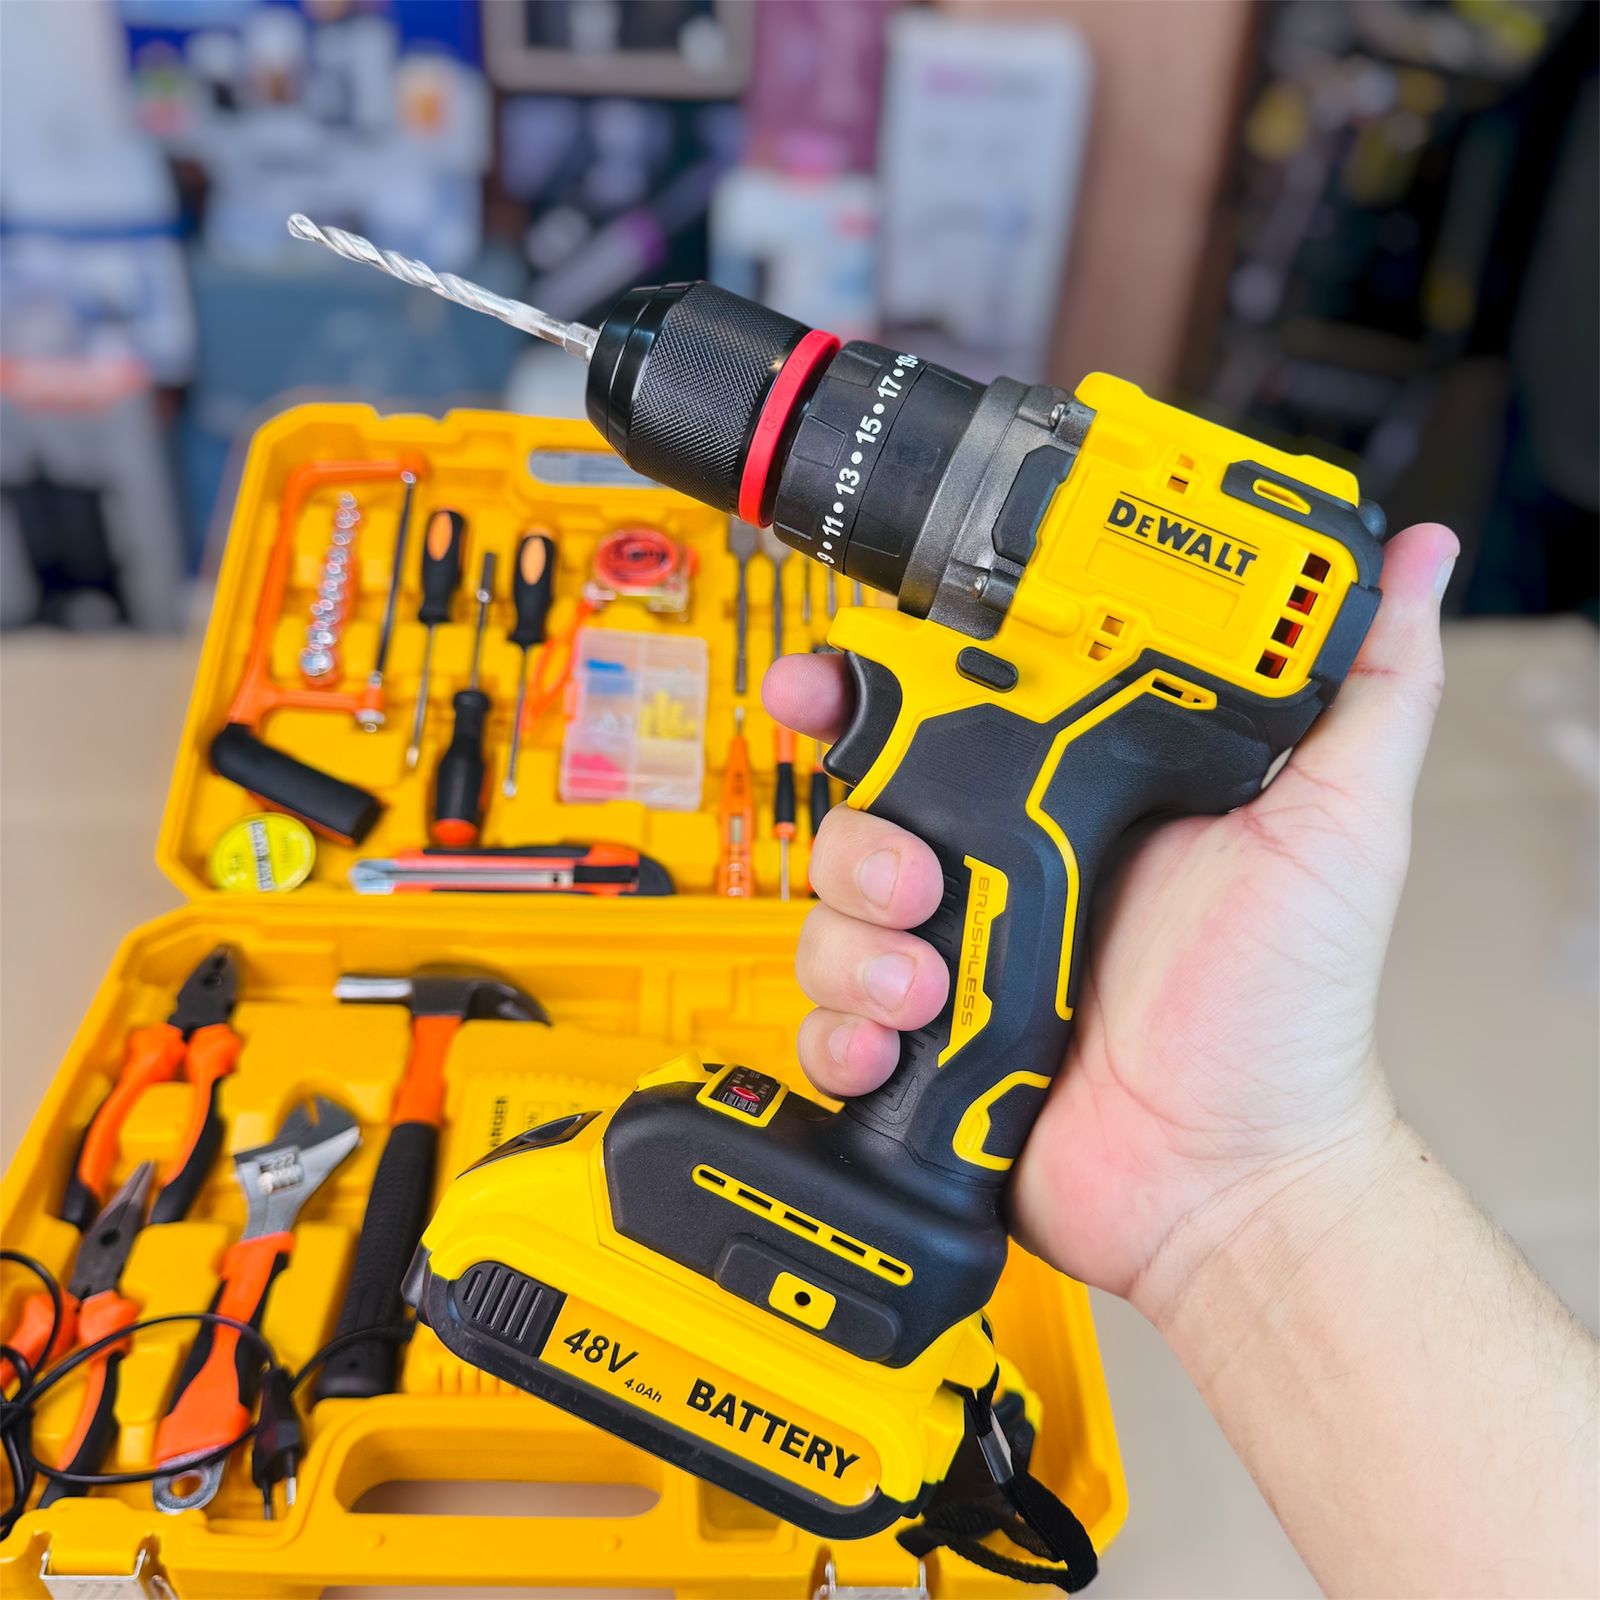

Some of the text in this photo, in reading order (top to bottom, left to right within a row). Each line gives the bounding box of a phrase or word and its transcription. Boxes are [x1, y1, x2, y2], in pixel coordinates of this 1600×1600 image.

[816, 354, 918, 564] 9 11 13 15 17 19
[961, 876, 989, 1027] BRUSHLESS
[563, 1327, 860, 1479] 48V 4.0Ah BATTERY
